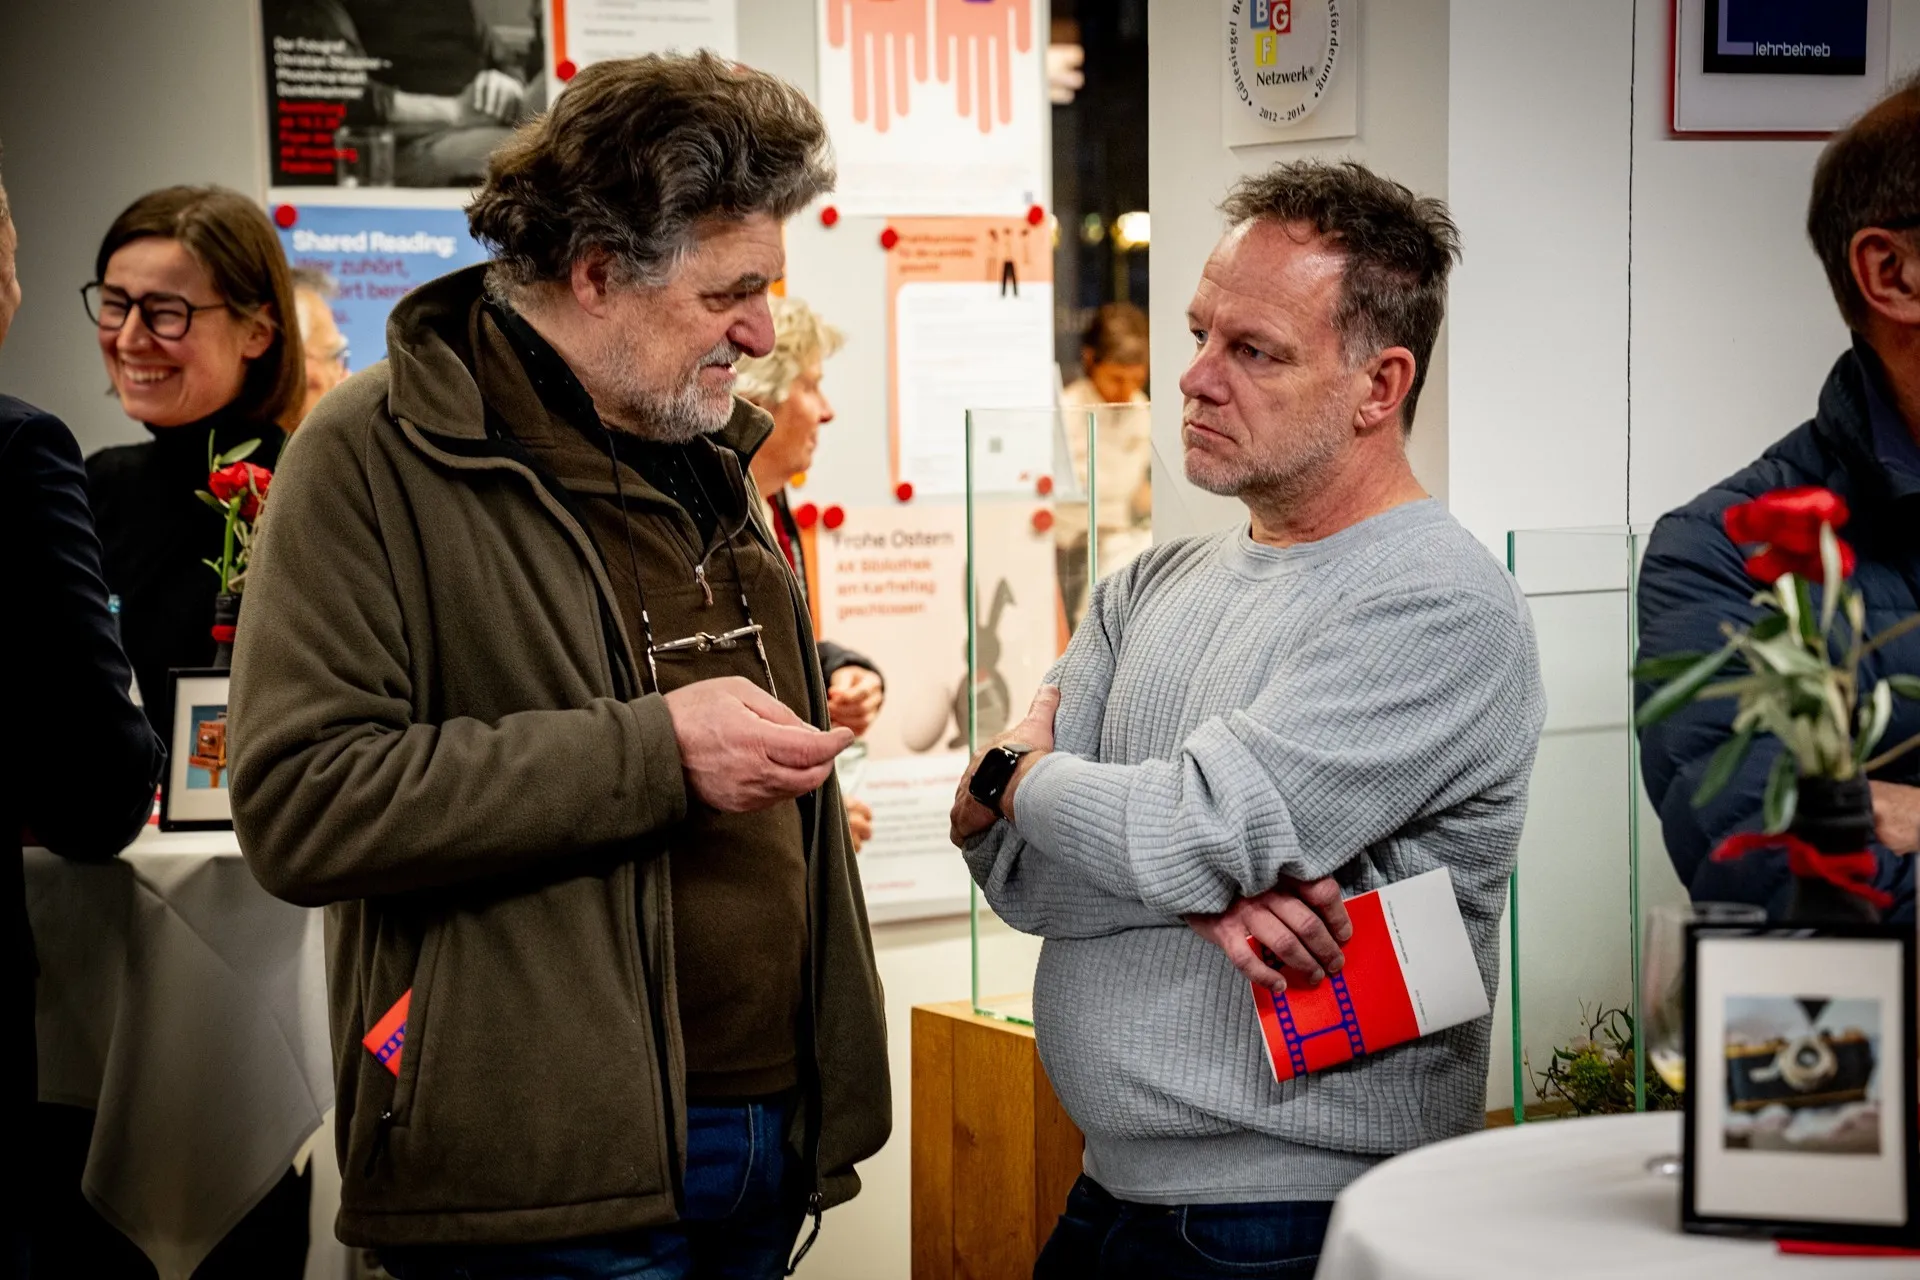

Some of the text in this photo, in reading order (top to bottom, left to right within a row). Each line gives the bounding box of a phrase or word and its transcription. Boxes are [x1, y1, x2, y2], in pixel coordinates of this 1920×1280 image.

[1755, 41, 1830, 57] lehrbetrieb
[1258, 106, 1278, 122] 2012
[1287, 103, 1306, 121] 2014
[292, 231, 366, 251] Shared
[833, 530, 954, 547] Frohe Ostern
